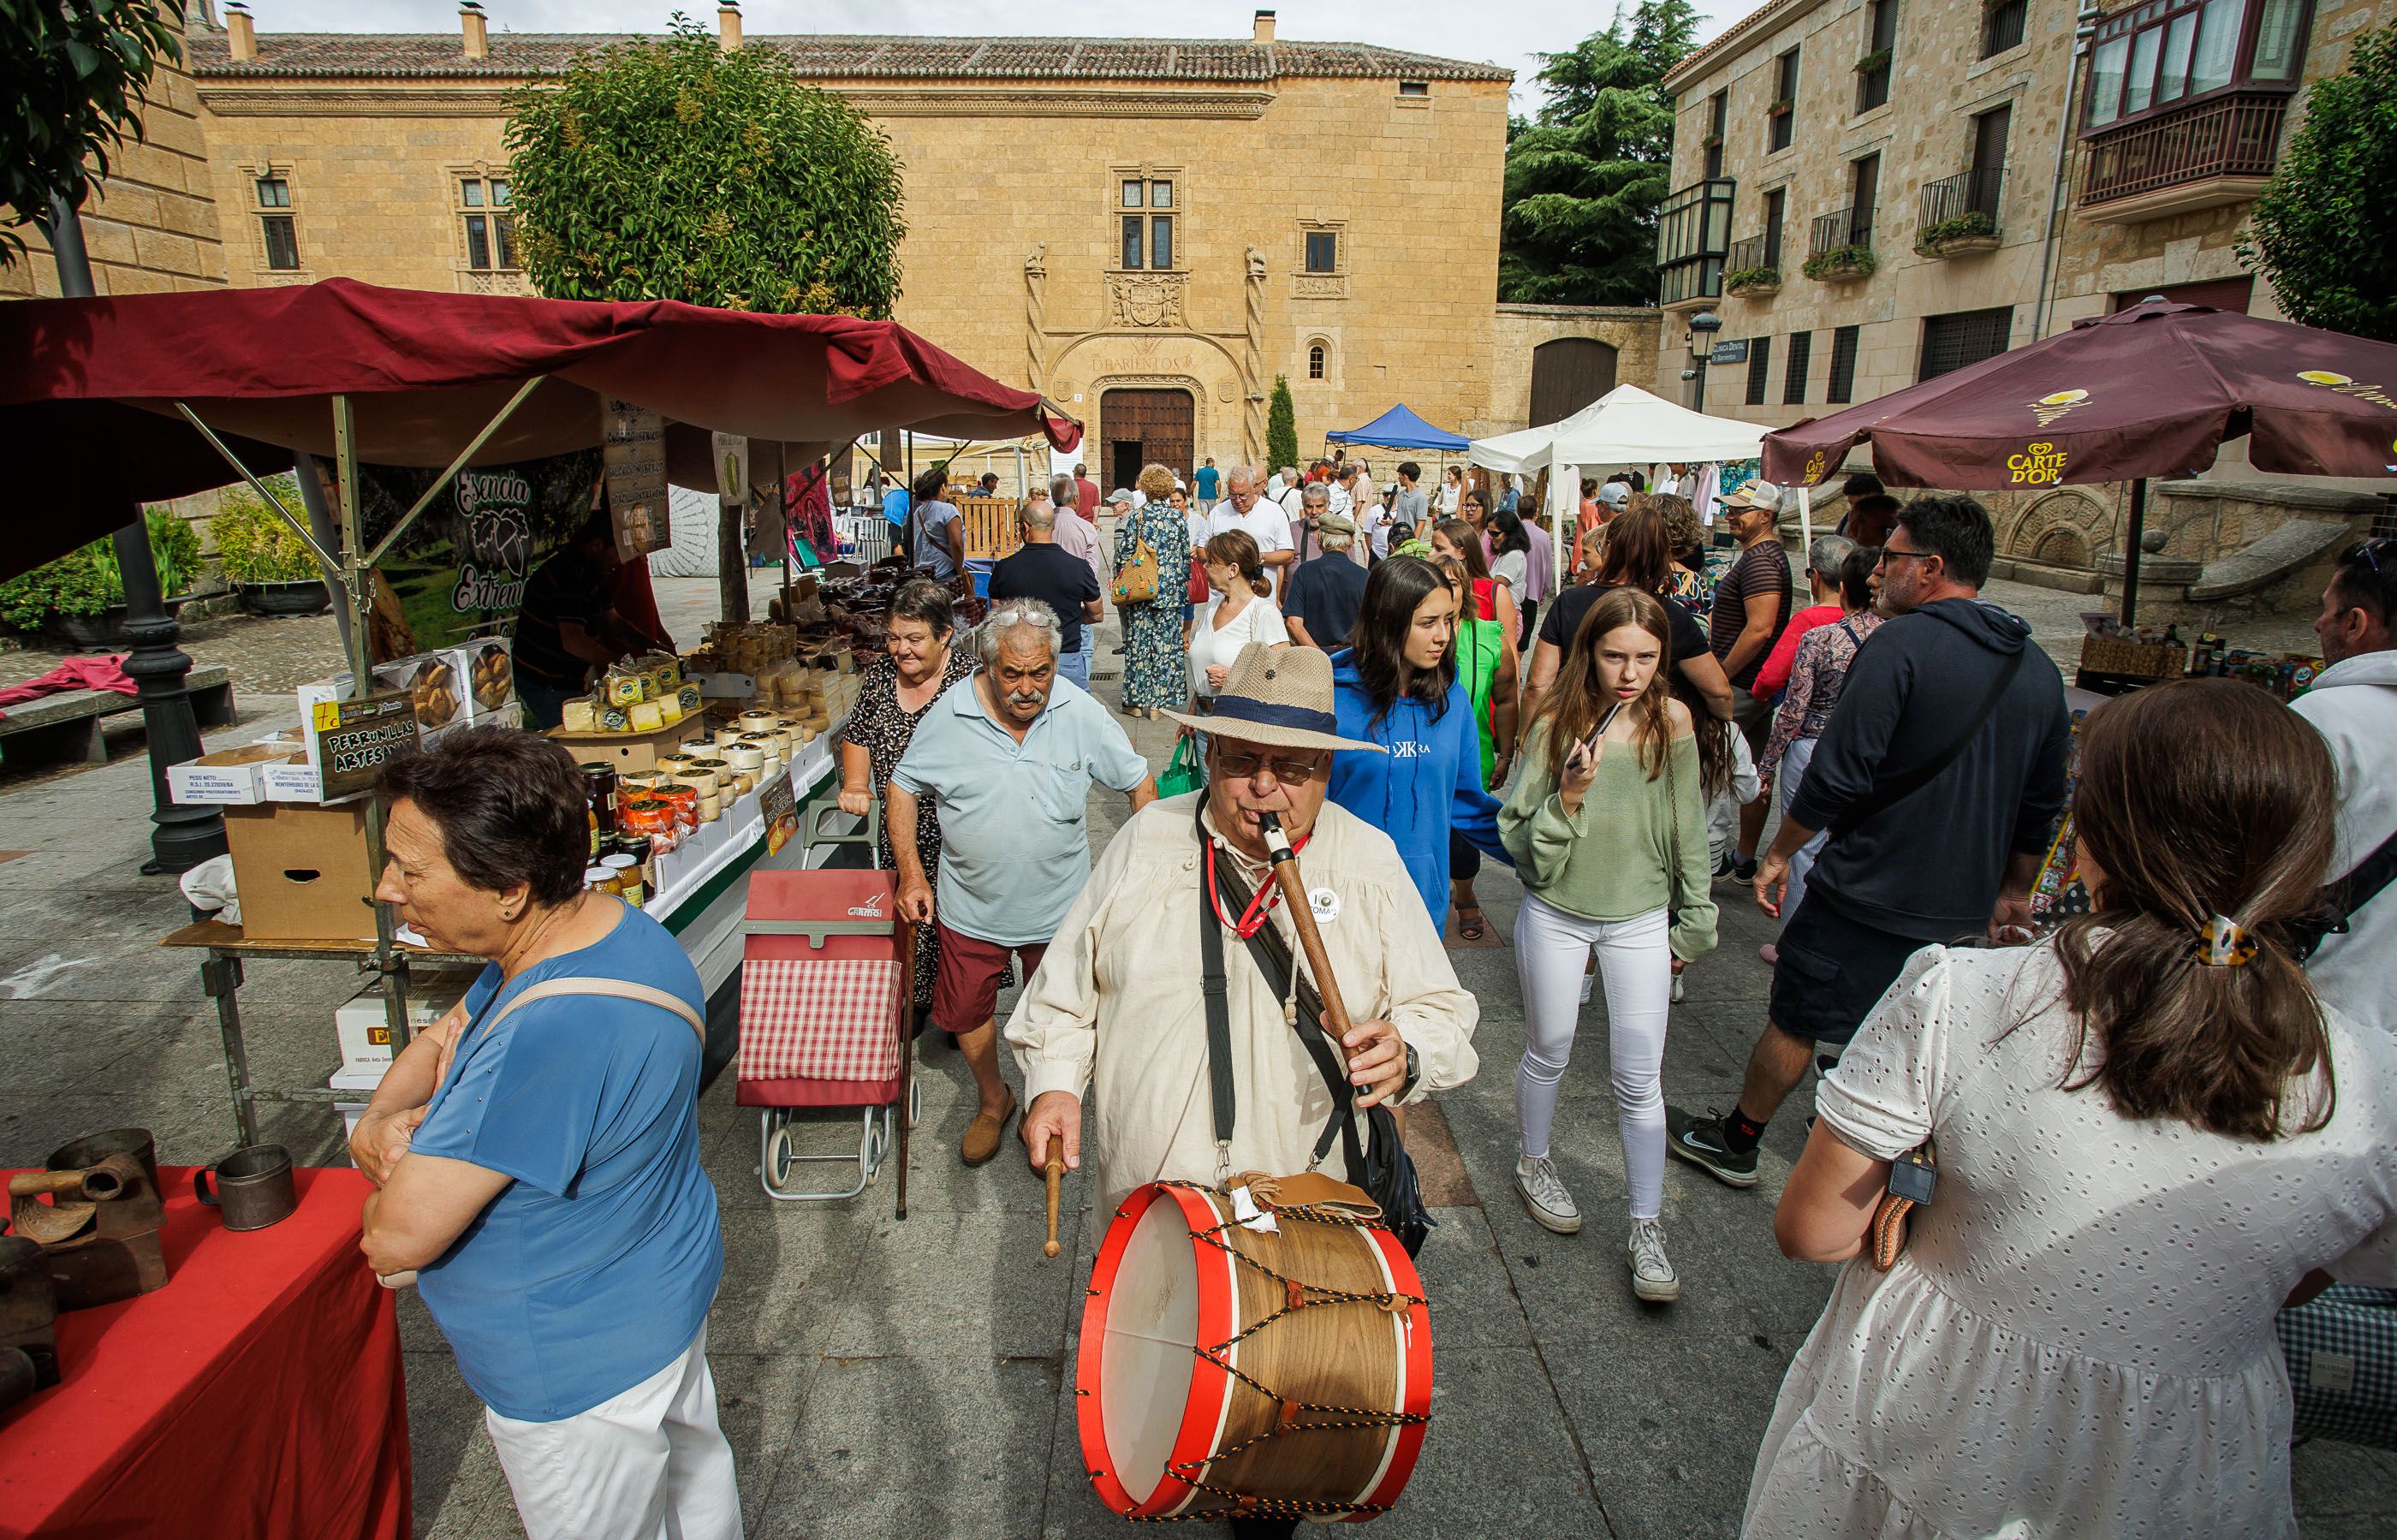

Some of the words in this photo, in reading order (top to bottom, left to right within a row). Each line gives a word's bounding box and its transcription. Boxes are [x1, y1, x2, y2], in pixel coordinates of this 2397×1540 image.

[2007, 452, 2067, 470] CARTE
[2011, 468, 2058, 485] D'OR
[455, 468, 530, 517] Esencia
[328, 720, 414, 753] PERRUNILLAS
